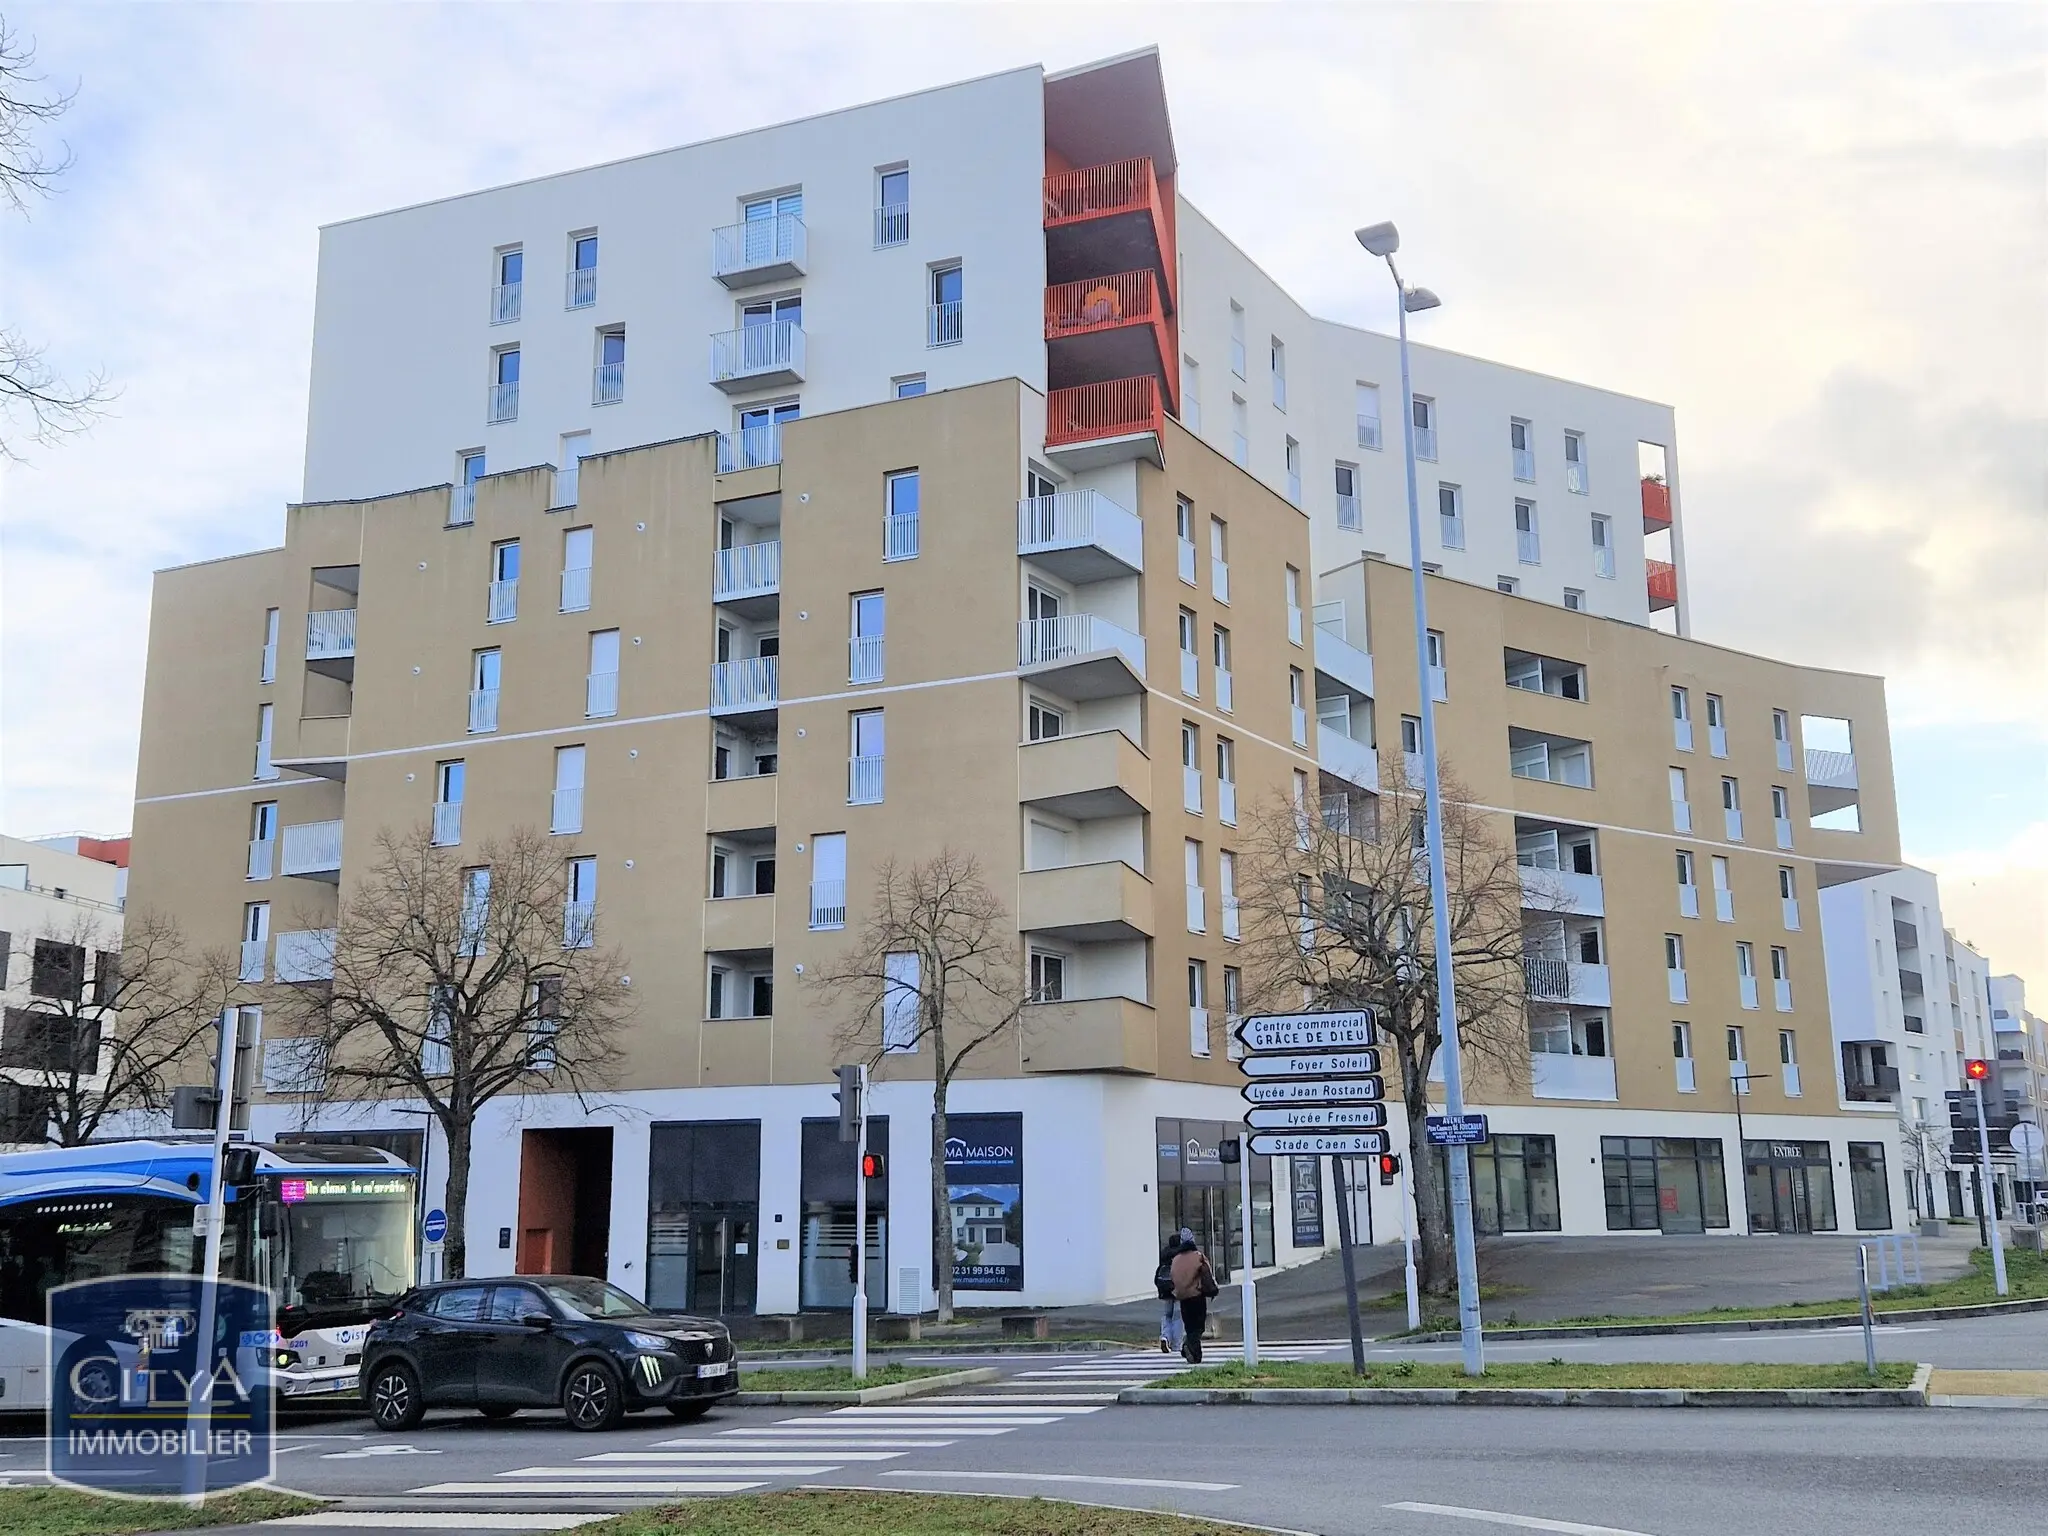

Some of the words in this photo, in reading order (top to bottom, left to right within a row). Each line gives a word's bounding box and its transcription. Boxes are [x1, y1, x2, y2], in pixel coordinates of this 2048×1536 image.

[1255, 1021, 1291, 1032] Centre
[1297, 1017, 1363, 1030] commercial
[1256, 1032, 1299, 1045] GRÂCE
[1307, 1032, 1323, 1043] DE
[1330, 1030, 1364, 1042] DIEU
[1291, 1060, 1323, 1071] Foyer
[1331, 1058, 1367, 1069] Soleil
[1254, 1087, 1284, 1099] Lycée
[1291, 1086, 1317, 1097] Jean
[1323, 1084, 1371, 1096] Rostand
[1288, 1113, 1320, 1125] Lycée
[1328, 1111, 1373, 1122] Fresnel
[1442, 1116, 1465, 1124] AVENUE
[1275, 1139, 1308, 1150] Stade
[1316, 1139, 1346, 1149] Caen
[1354, 1138, 1377, 1149] Sud
[945, 1147, 963, 1158] MA
[966, 1146, 1013, 1158] MAISON
[961, 1266, 970, 1275] 31
[972, 1266, 983, 1275] 99
[984, 1266, 994, 1275] 94
[995, 1266, 1006, 1275] 58
